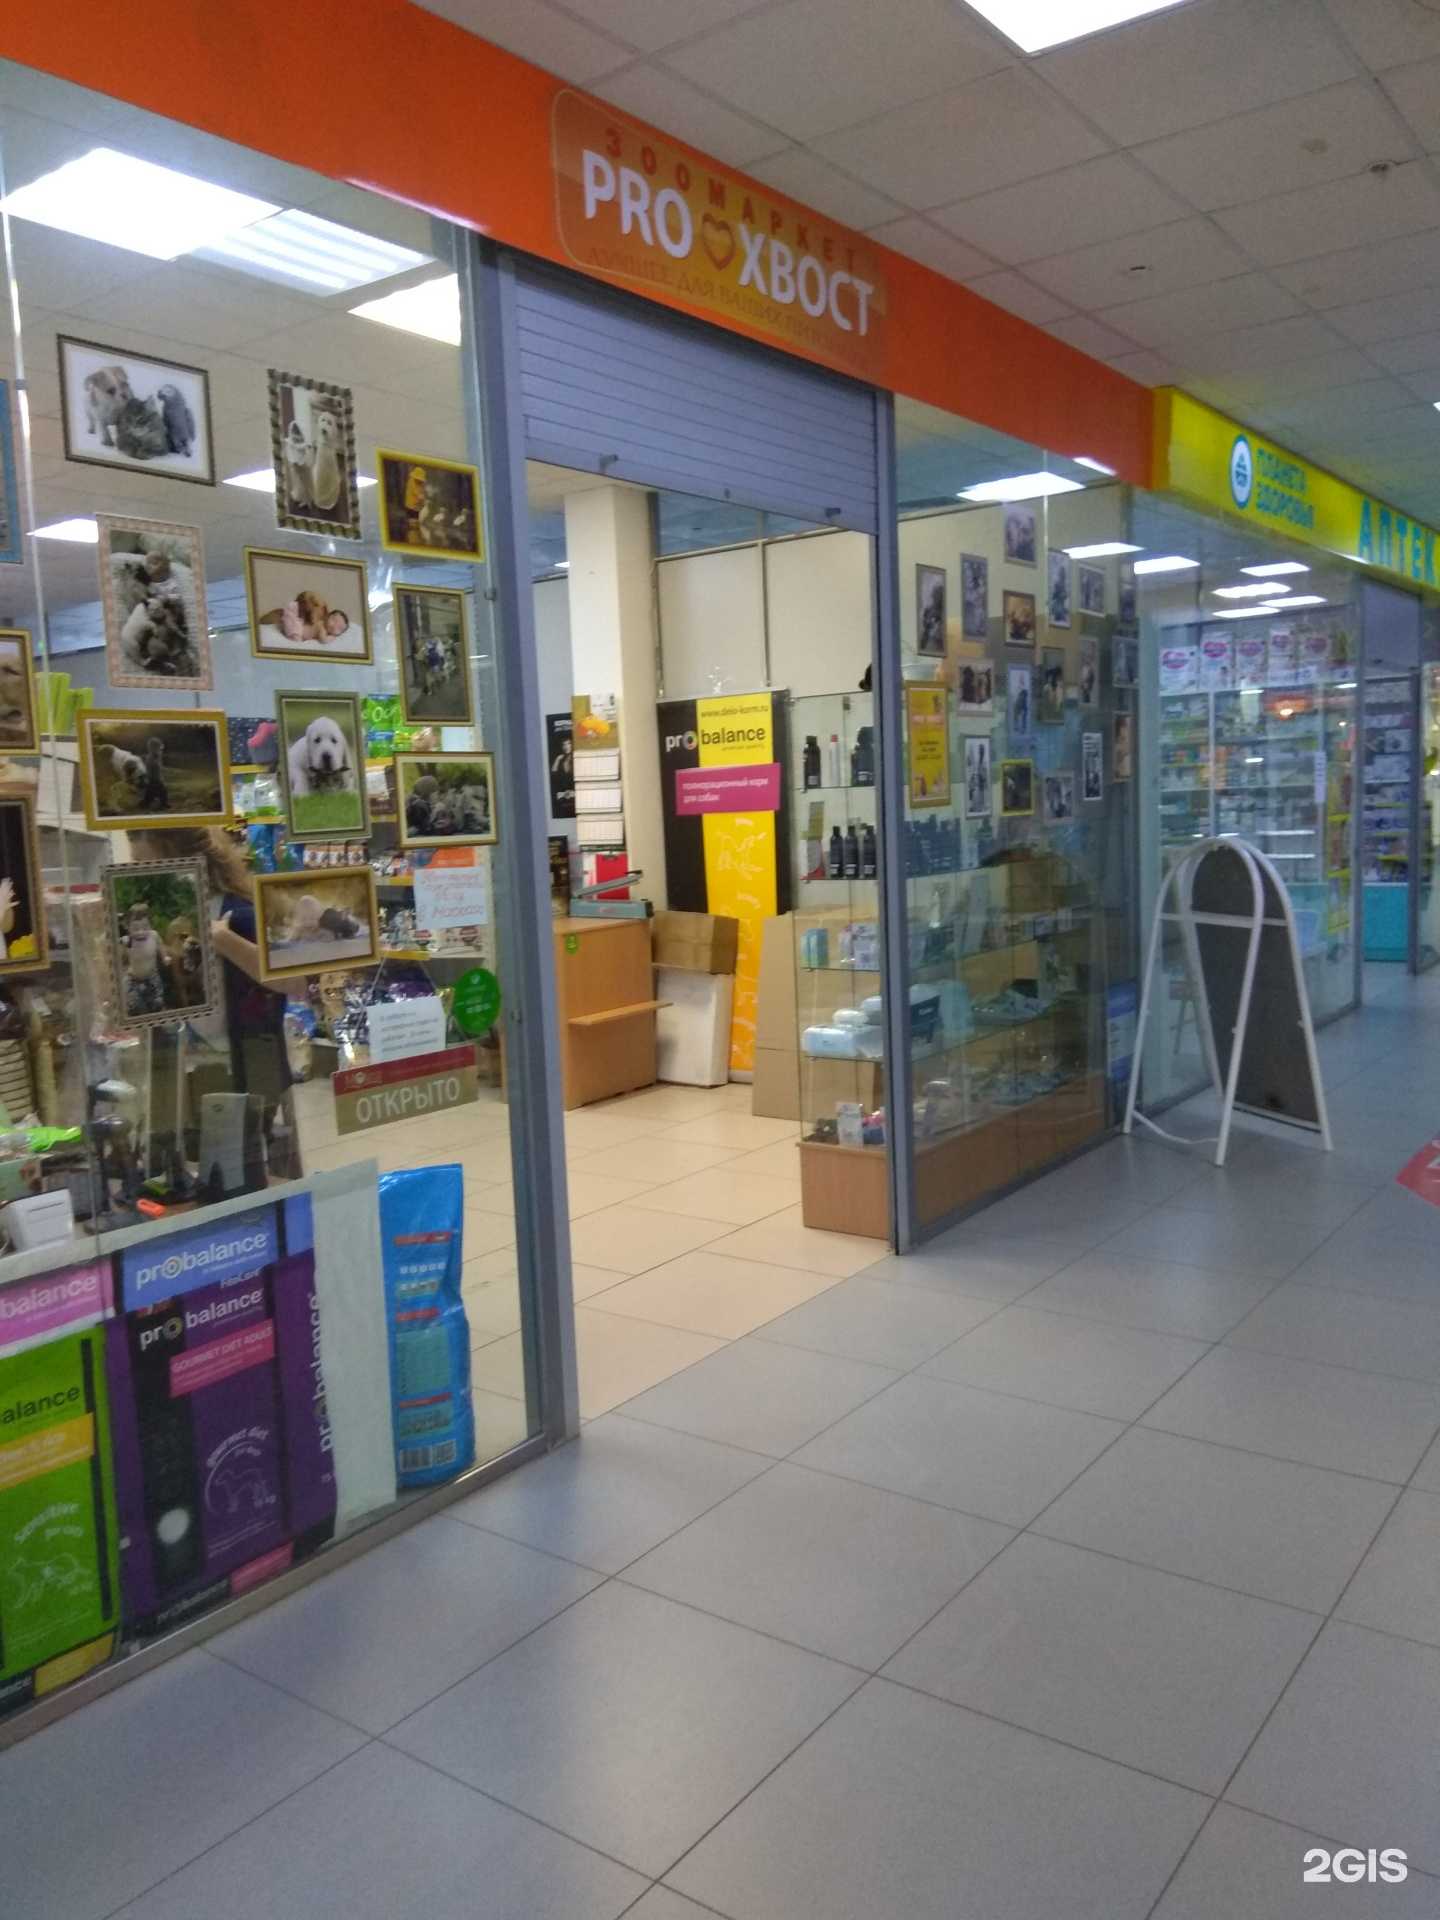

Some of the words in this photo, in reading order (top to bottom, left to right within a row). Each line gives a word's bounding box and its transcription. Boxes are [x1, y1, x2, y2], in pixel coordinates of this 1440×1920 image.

[582, 149, 693, 259] PRO
[606, 128, 858, 272] ЗООМАРКЕТ
[738, 223, 874, 336] ХВОСТ
[356, 1077, 460, 1123] ОТКРЫТО
